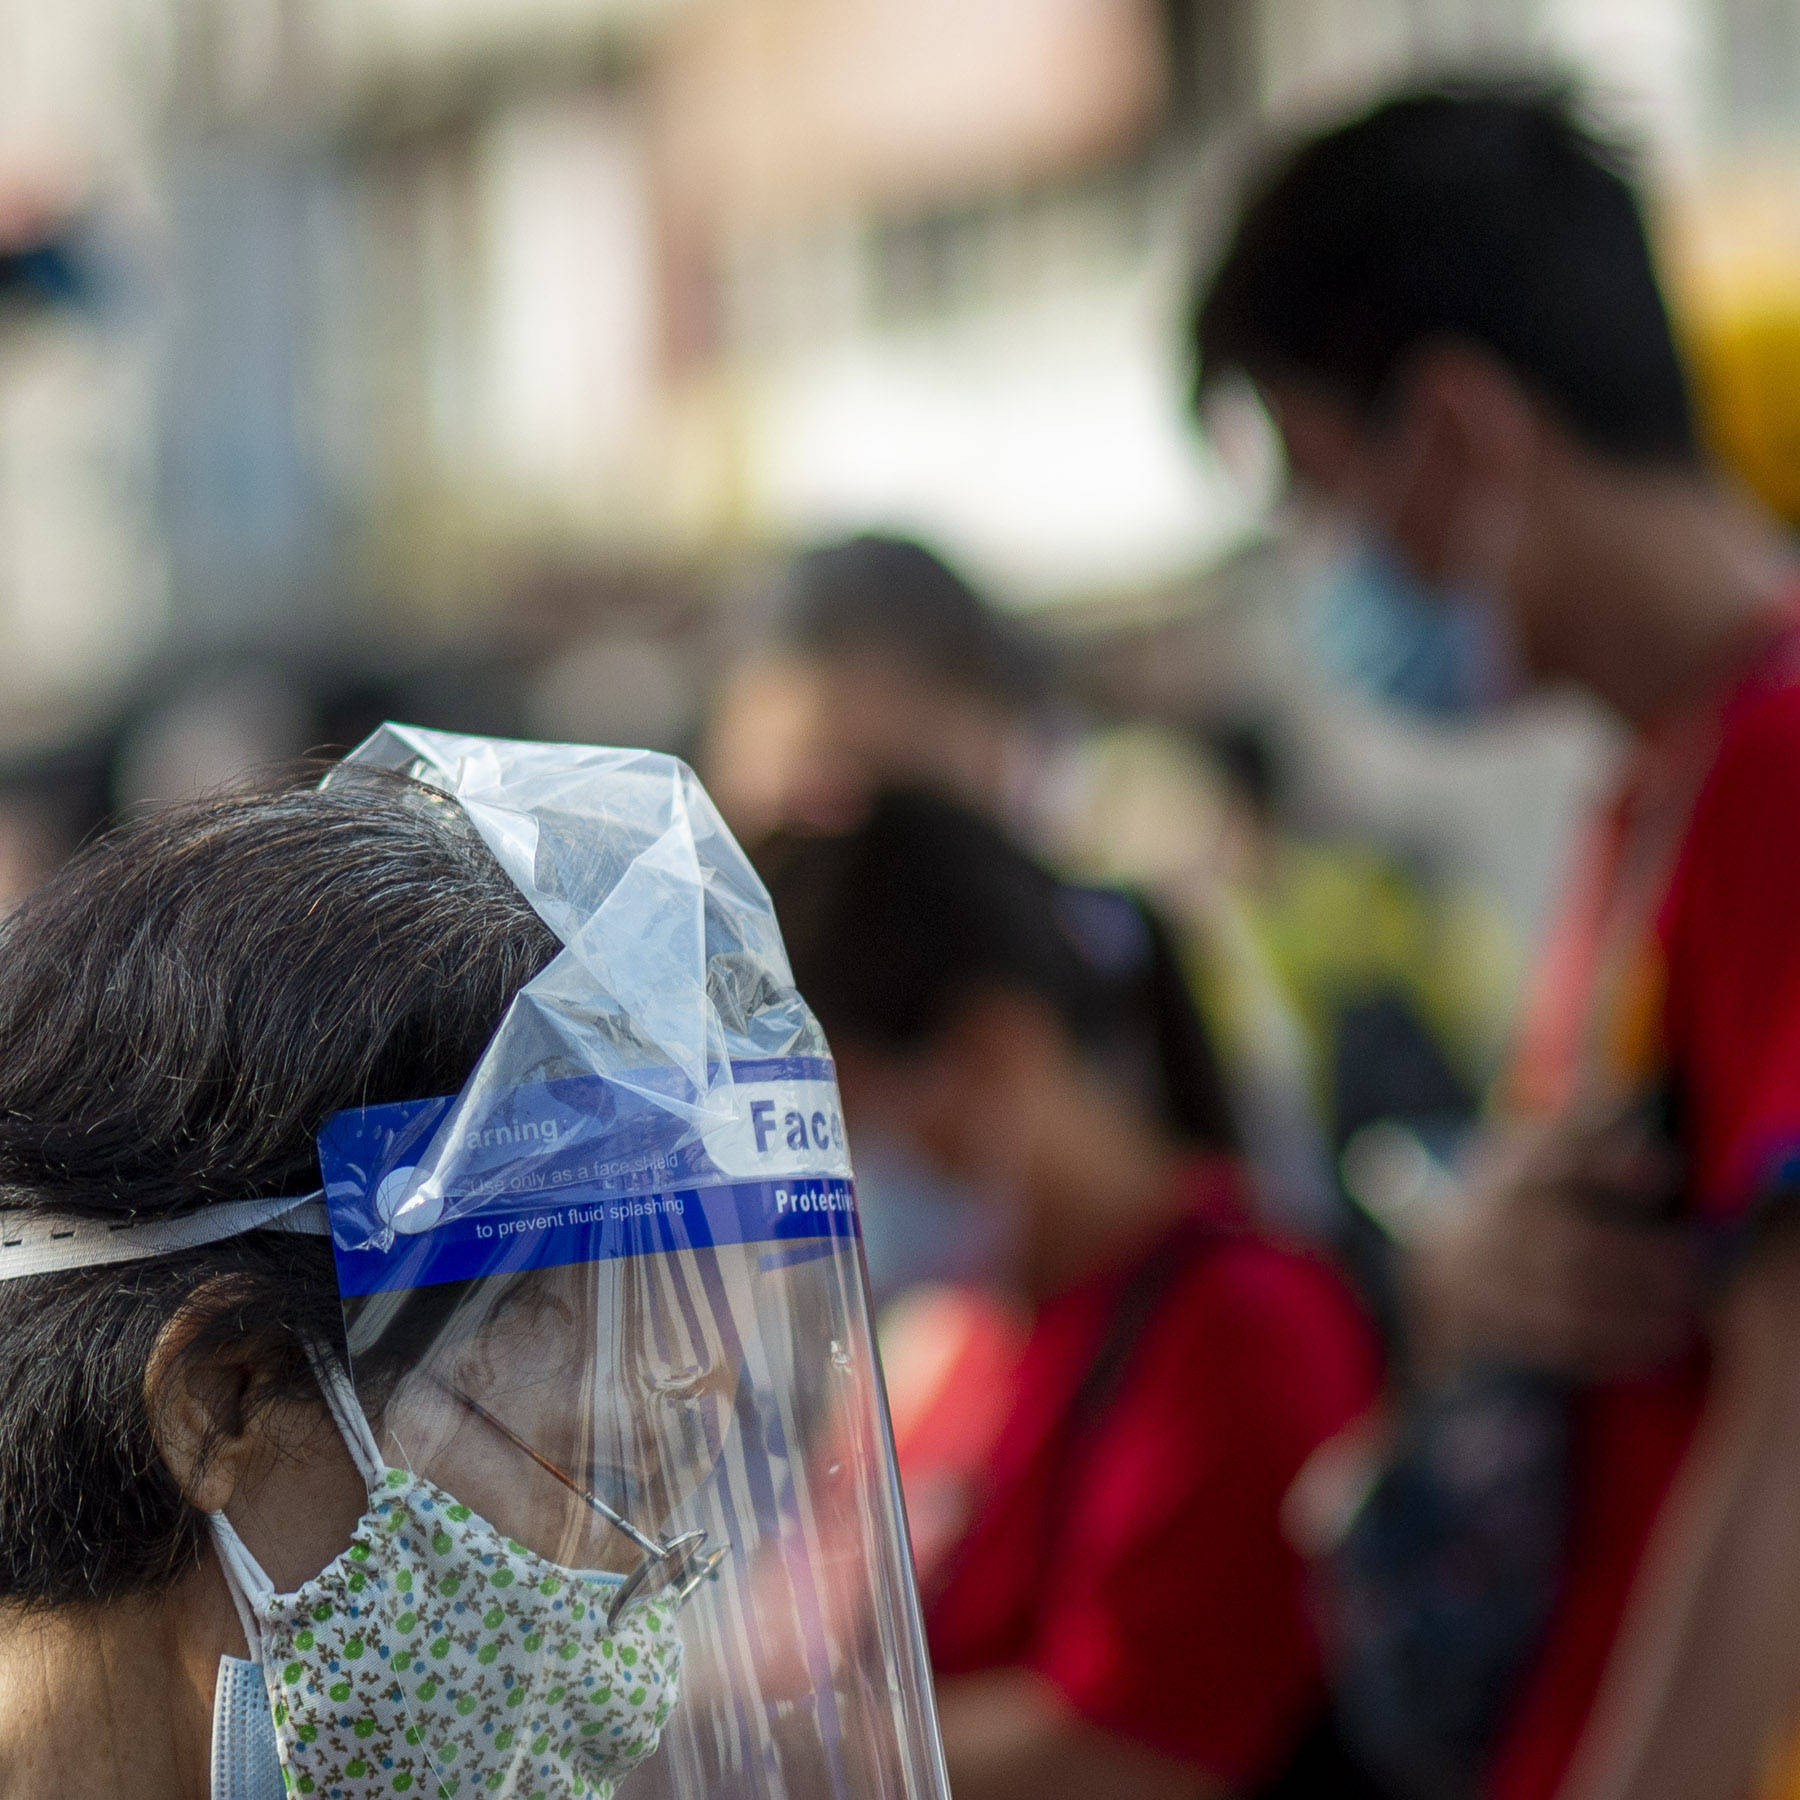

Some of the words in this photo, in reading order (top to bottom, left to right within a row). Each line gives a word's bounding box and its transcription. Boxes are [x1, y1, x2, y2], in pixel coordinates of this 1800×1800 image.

[510, 1171, 546, 1190] only
[552, 1168, 572, 1183] as
[577, 1166, 589, 1179] a
[593, 1160, 629, 1177] face
[634, 1152, 678, 1171] shield
[475, 1224, 493, 1239] to
[498, 1211, 564, 1239] prevent
[568, 1204, 604, 1224] fluid
[609, 1197, 685, 1222] splashing
